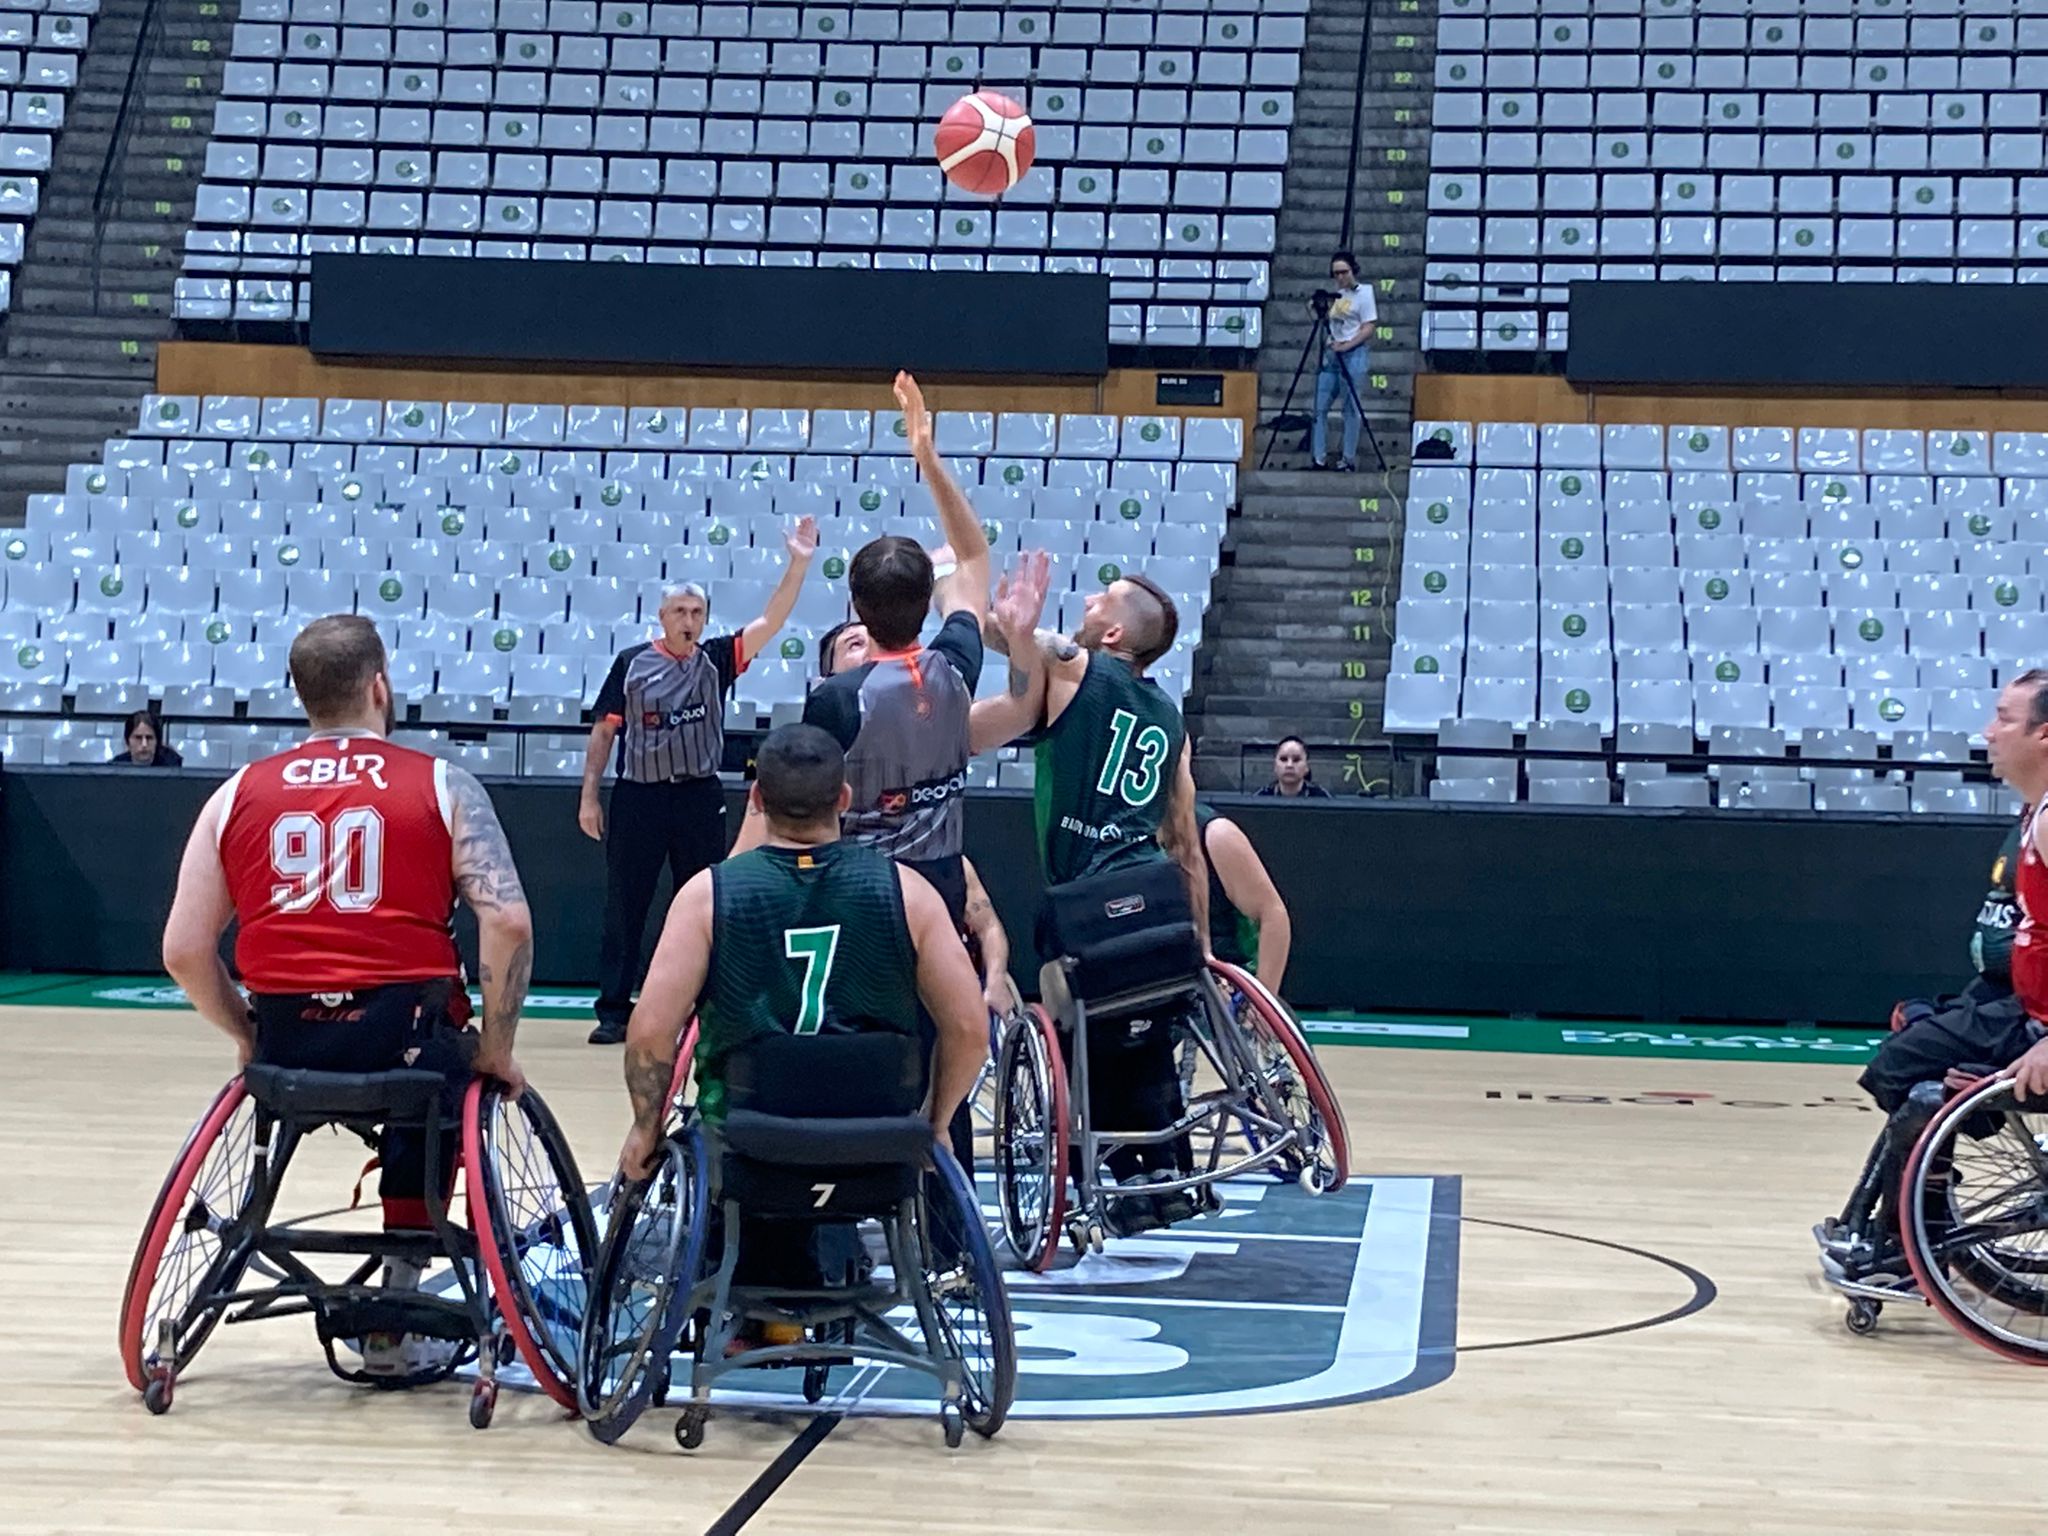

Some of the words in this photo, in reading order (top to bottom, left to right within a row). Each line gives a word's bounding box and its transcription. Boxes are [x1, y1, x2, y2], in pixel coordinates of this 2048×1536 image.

[192, 40, 210, 52] 22
[1395, 35, 1415, 47] 23
[1394, 71, 1412, 83] 22
[171, 116, 191, 129] 20
[1394, 109, 1410, 122] 21
[1387, 149, 1406, 161] 20
[166, 158, 182, 172] 19
[144, 245, 160, 258] 17
[1380, 279, 1395, 292] 17
[1376, 326, 1393, 340] 16
[121, 340, 138, 355] 15
[1371, 375, 1387, 388] 15
[1359, 498, 1378, 512] 14
[1354, 547, 1374, 562] 13
[1351, 590, 1371, 607] 12
[1353, 625, 1370, 640] 11
[1345, 662, 1366, 680] 10
[1349, 701, 1363, 718] 9
[1096, 708, 1169, 806] 13
[281, 754, 389, 790] CBLR
[1342, 765, 1355, 781] 7
[269, 805, 385, 914] 90
[784, 924, 841, 1036] 7
[810, 1183, 837, 1208] 7
